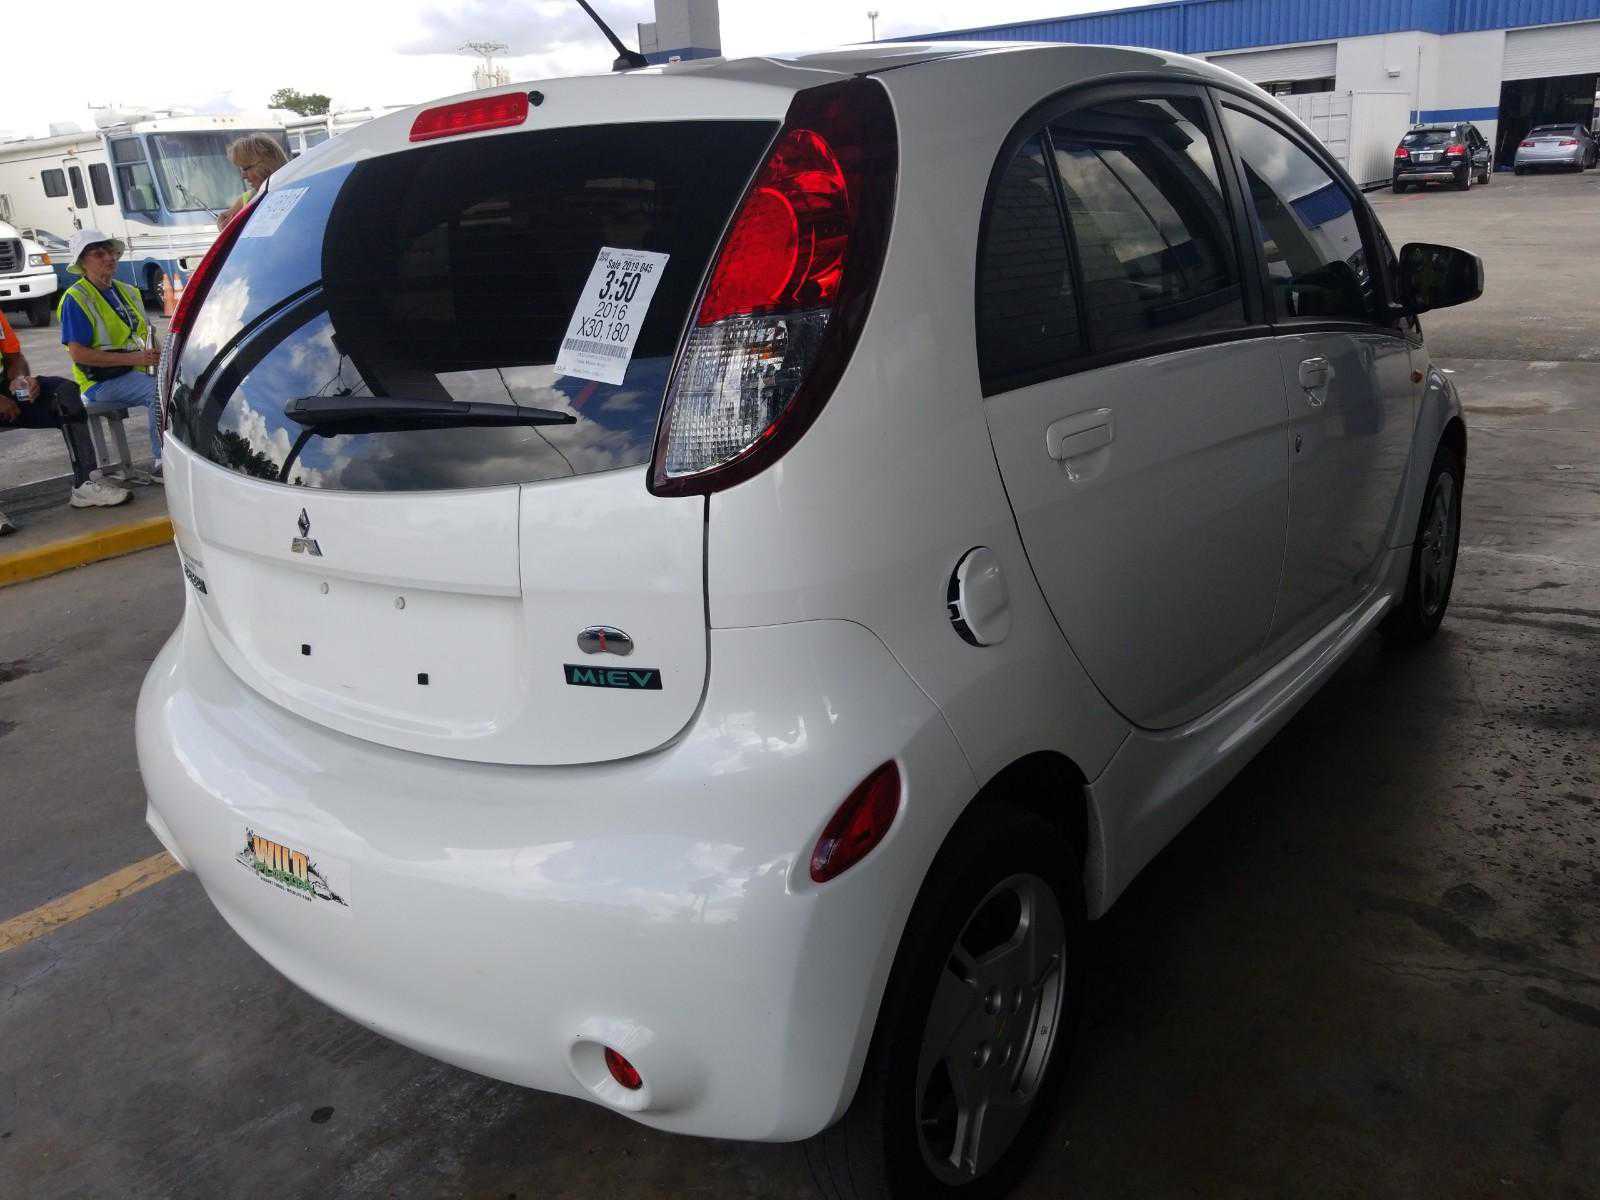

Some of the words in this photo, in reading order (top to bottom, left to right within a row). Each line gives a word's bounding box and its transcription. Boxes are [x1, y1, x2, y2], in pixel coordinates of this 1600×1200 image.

[606, 260, 621, 271] Sale
[599, 270, 641, 303] 3:50
[594, 302, 628, 320] 2016
